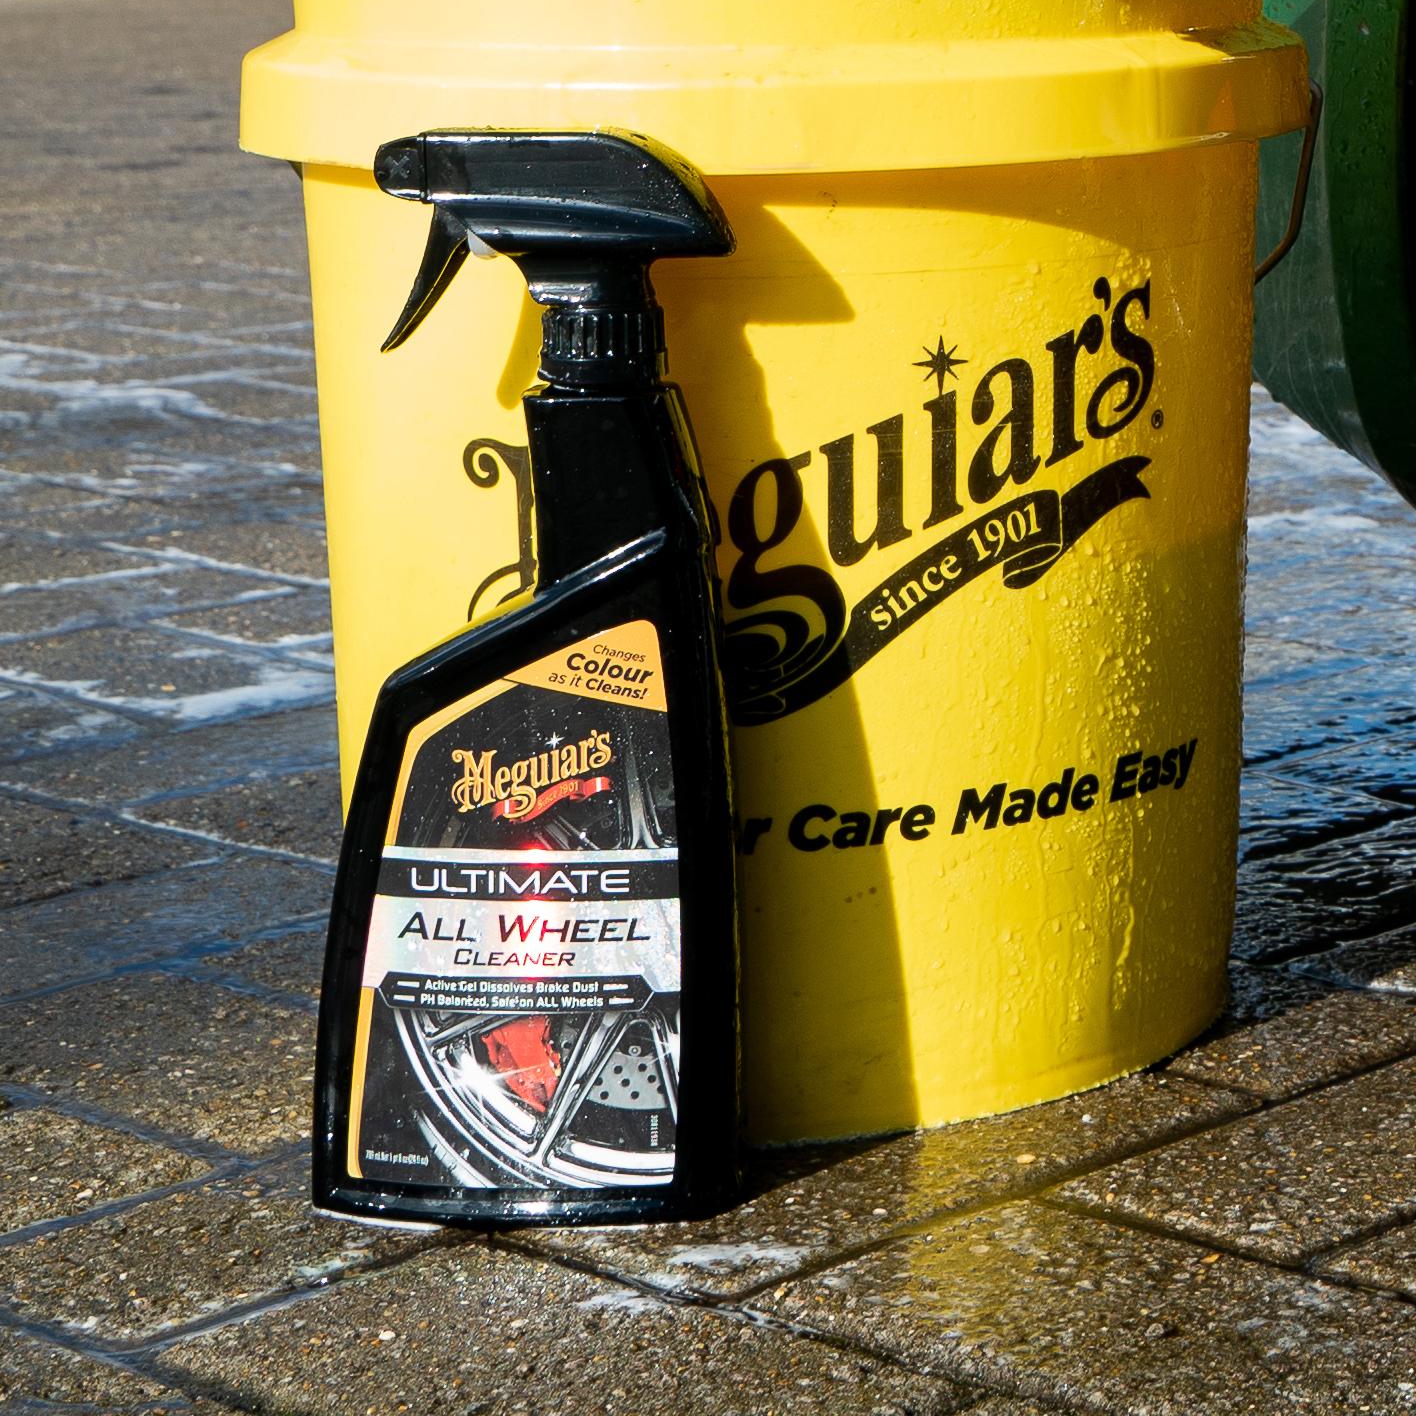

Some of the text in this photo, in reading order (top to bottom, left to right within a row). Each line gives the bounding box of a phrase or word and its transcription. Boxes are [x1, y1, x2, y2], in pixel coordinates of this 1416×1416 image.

[870, 501, 1041, 633] since 1901
[593, 644, 646, 662] Changes
[566, 653, 654, 683] Colour
[548, 672, 648, 699] as it Cleans!
[452, 730, 612, 819] Meguiar's
[788, 803, 936, 853] Care
[951, 775, 1097, 838] Made
[1109, 737, 1199, 803] Easy
[410, 867, 631, 894] ULTIMATE
[397, 911, 652, 943] ALL WHEEL
[453, 947, 576, 967] CLEANER
[424, 979, 599, 994] Active Gel Dissolves Brake Dust
[491, 995, 516, 1007] Safe
[517, 997, 534, 1008] on
[536, 995, 556, 1007] ALL
[558, 996, 604, 1008] Wheels
